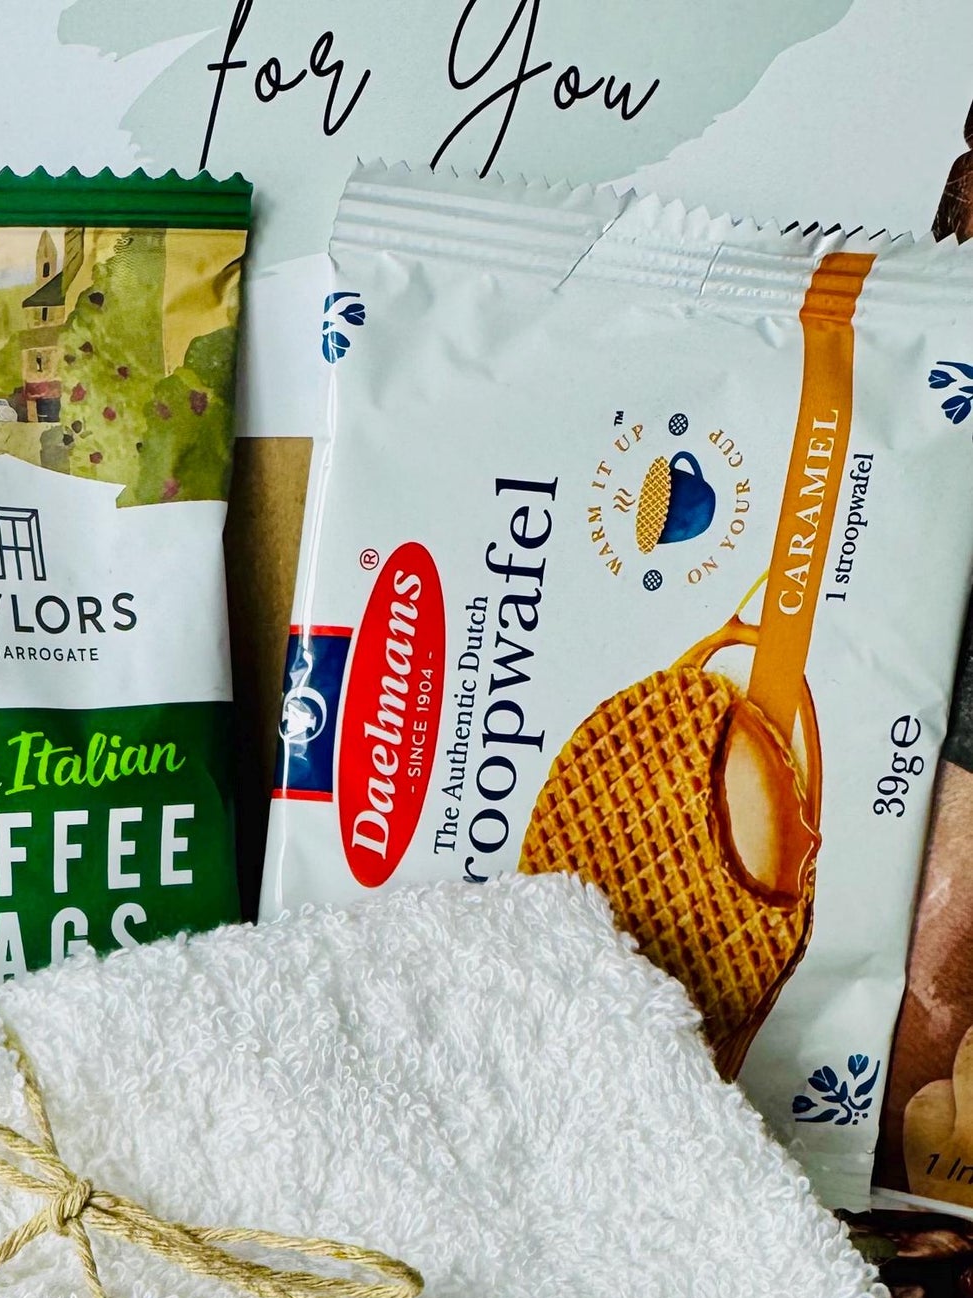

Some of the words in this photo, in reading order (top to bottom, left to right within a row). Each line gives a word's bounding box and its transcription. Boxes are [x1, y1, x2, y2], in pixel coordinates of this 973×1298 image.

[429, 0, 660, 179] You
[615, 424, 643, 452] UP
[709, 429, 743, 468] CUP
[592, 460, 612, 489] IT
[588, 506, 623, 576] WARM
[720, 478, 751, 550] YOUR
[778, 409, 840, 615] CARAMEL
[835, 454, 874, 584] stroopwafel
[687, 556, 719, 584] ON
[459, 594, 489, 673] Dutch
[352, 568, 423, 860] Daelmans
[416, 668, 434, 713] 1904
[4, 730, 186, 797] Italian
[407, 720, 428, 778] SINCE
[441, 679, 477, 801] Authentic
[434, 807, 461, 855] The
